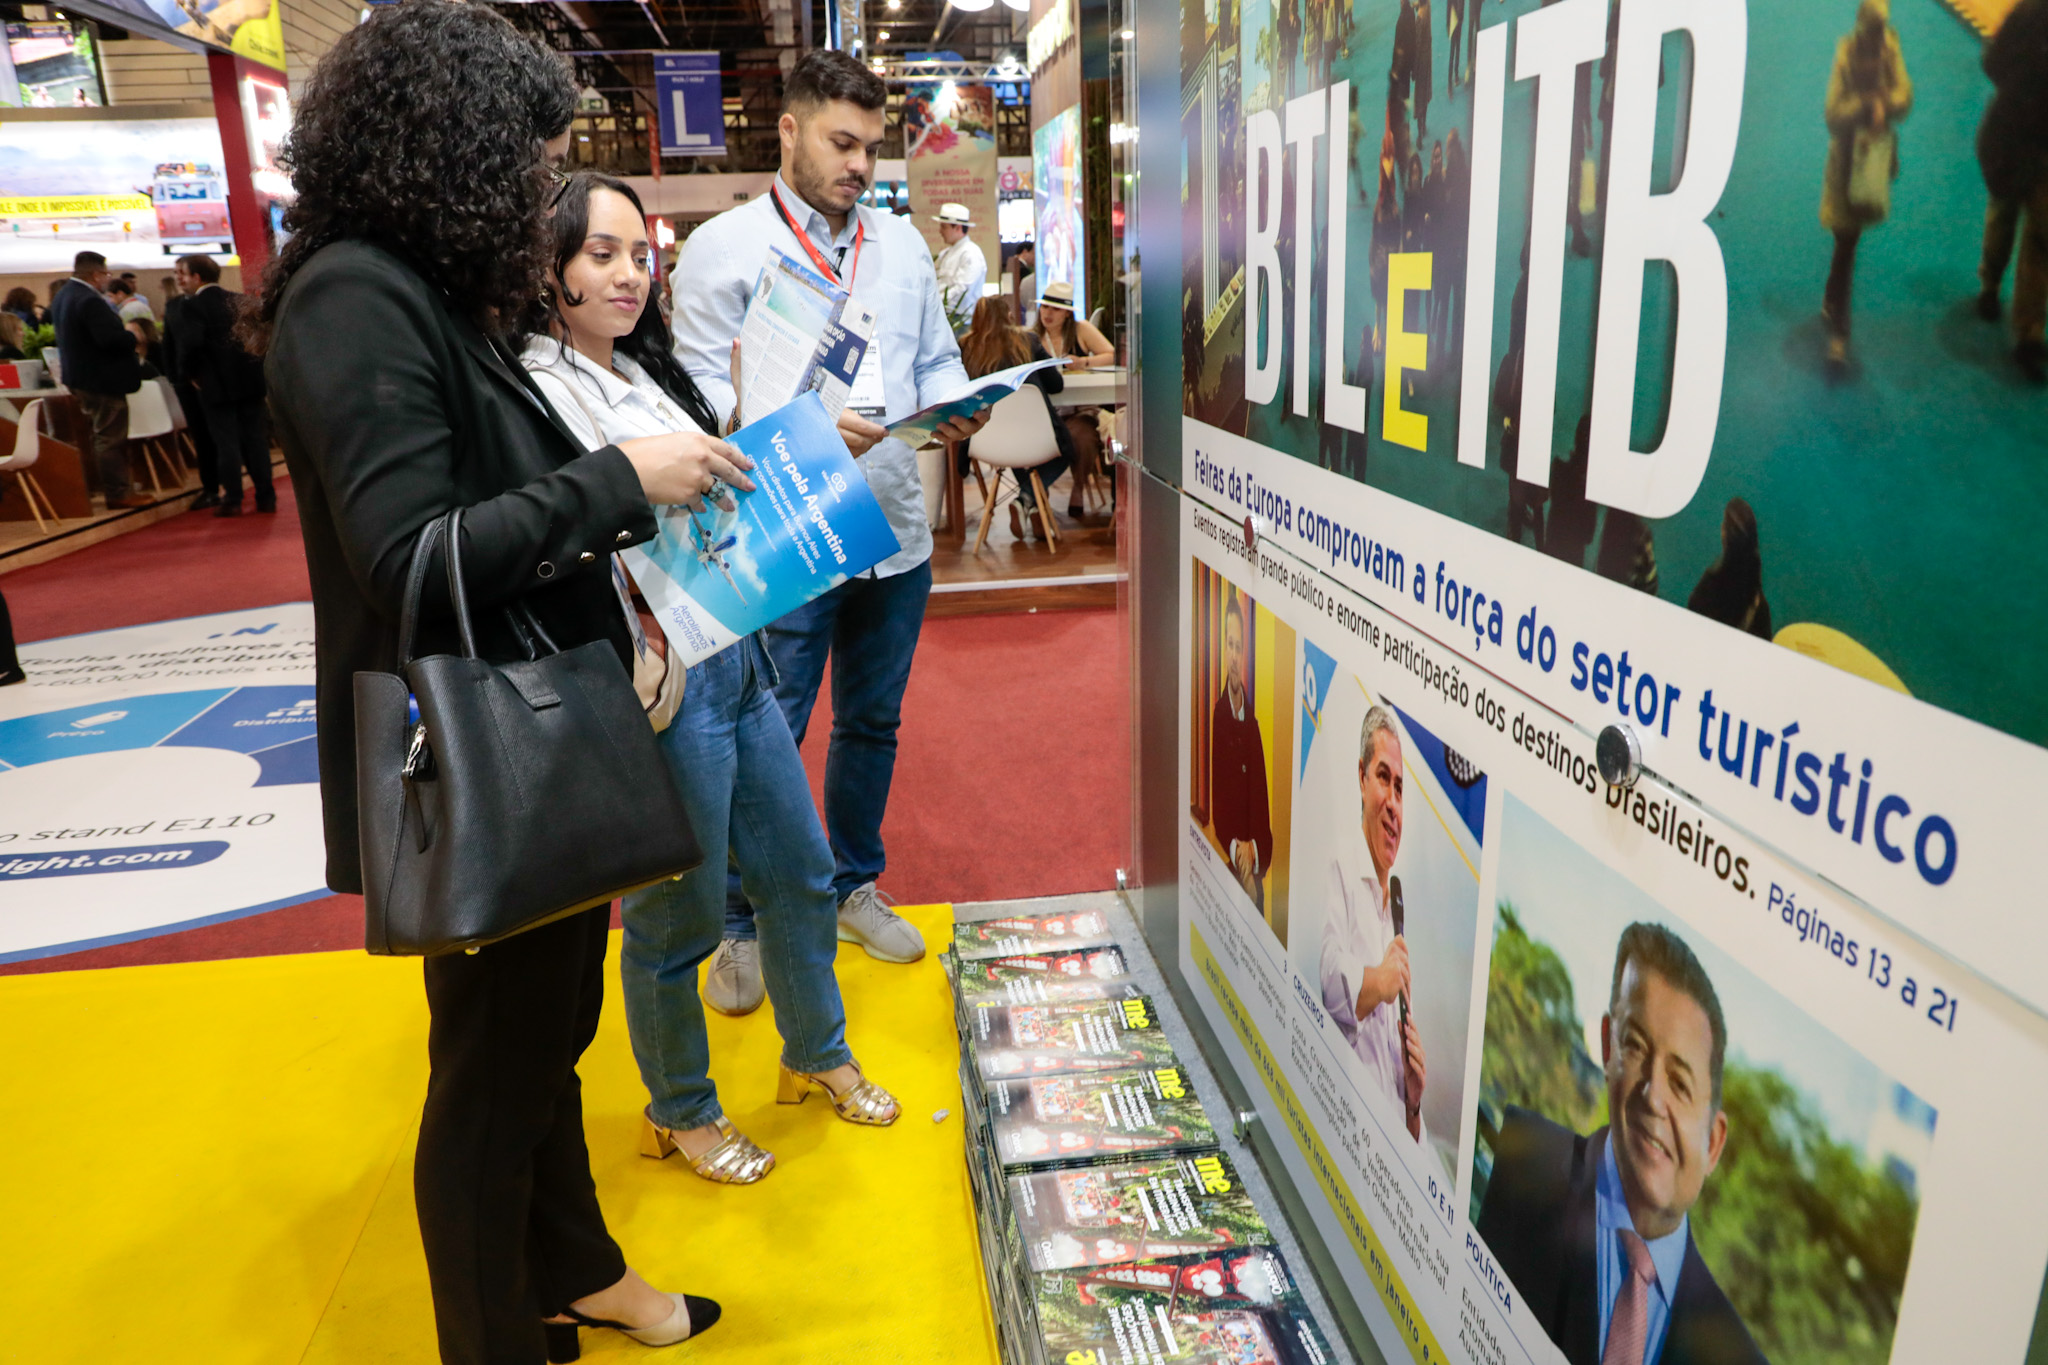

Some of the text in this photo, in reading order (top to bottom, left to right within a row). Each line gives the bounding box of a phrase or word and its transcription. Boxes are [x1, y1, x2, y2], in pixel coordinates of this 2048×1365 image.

[672, 90, 711, 146] L
[923, 188, 949, 196] TODAS
[1245, 0, 1747, 519] BTL E ITB
[747, 454, 759, 472] com
[756, 470, 778, 505] conexões
[773, 503, 787, 521] para
[783, 518, 797, 537] toda
[795, 540, 817, 575] Argentina
[762, 456, 821, 560] Voos diretos para Buenos Aires
[770, 430, 791, 463] Voe
[782, 462, 809, 495] pela
[803, 494, 847, 565] Argentina
[127, 642, 284, 660] melhores
[670, 607, 701, 652] Argentinas
[678, 605, 709, 649] Aerolíneas
[165, 666, 257, 677] hotéis
[1195, 449, 1958, 887] Feiras da Europa comprovam a força do setor turístico
[1194, 508, 1217, 540] Eventos
[1260, 553, 1289, 588] grande
[1290, 570, 1324, 612] público
[1327, 596, 1334, 618] e
[1337, 606, 1381, 649] enorme
[1384, 631, 1469, 708] participação
[1475, 688, 1506, 733] dos
[1512, 712, 1598, 795] destinos
[1767, 882, 1860, 968] Páginas
[1867, 947, 1893, 989] 13
[1900, 977, 1919, 1007] a
[1928, 987, 1959, 1033] 21
[28, 820, 156, 842] stand
[162, 812, 276, 833] E110
[1284, 960, 1288, 974] 3
[1293, 975, 1324, 1029] CRUZEIROS
[1205, 956, 1430, 1361] Brasil recebe mais de 868 mil turistas internacionais em janeiro e
[1291, 1047, 1423, 1274] Roteiro contemplou países do Oriente Médio.
[1291, 1035, 1448, 1296] primeira Convenção de Vendas Internacional.
[1292, 1017, 1449, 1276] Costa Cruzeiros reúne 60 operadores na sua
[1148, 1176, 1160, 1190] EM
[1161, 1178, 1191, 1232] IMAGINAÇÕES
[1174, 1177, 1202, 1229] TRANSFORME
[1428, 1175, 1454, 1226] 10 E 11
[1153, 1188, 1184, 1237] ITINERÁRIOS
[1466, 1232, 1512, 1315] POLÍTICA
[1108, 1306, 1134, 1365] TRANSFORME
[1122, 1303, 1149, 1365] IMAGINAÇÕES
[1462, 1287, 1506, 1365] Entidades
